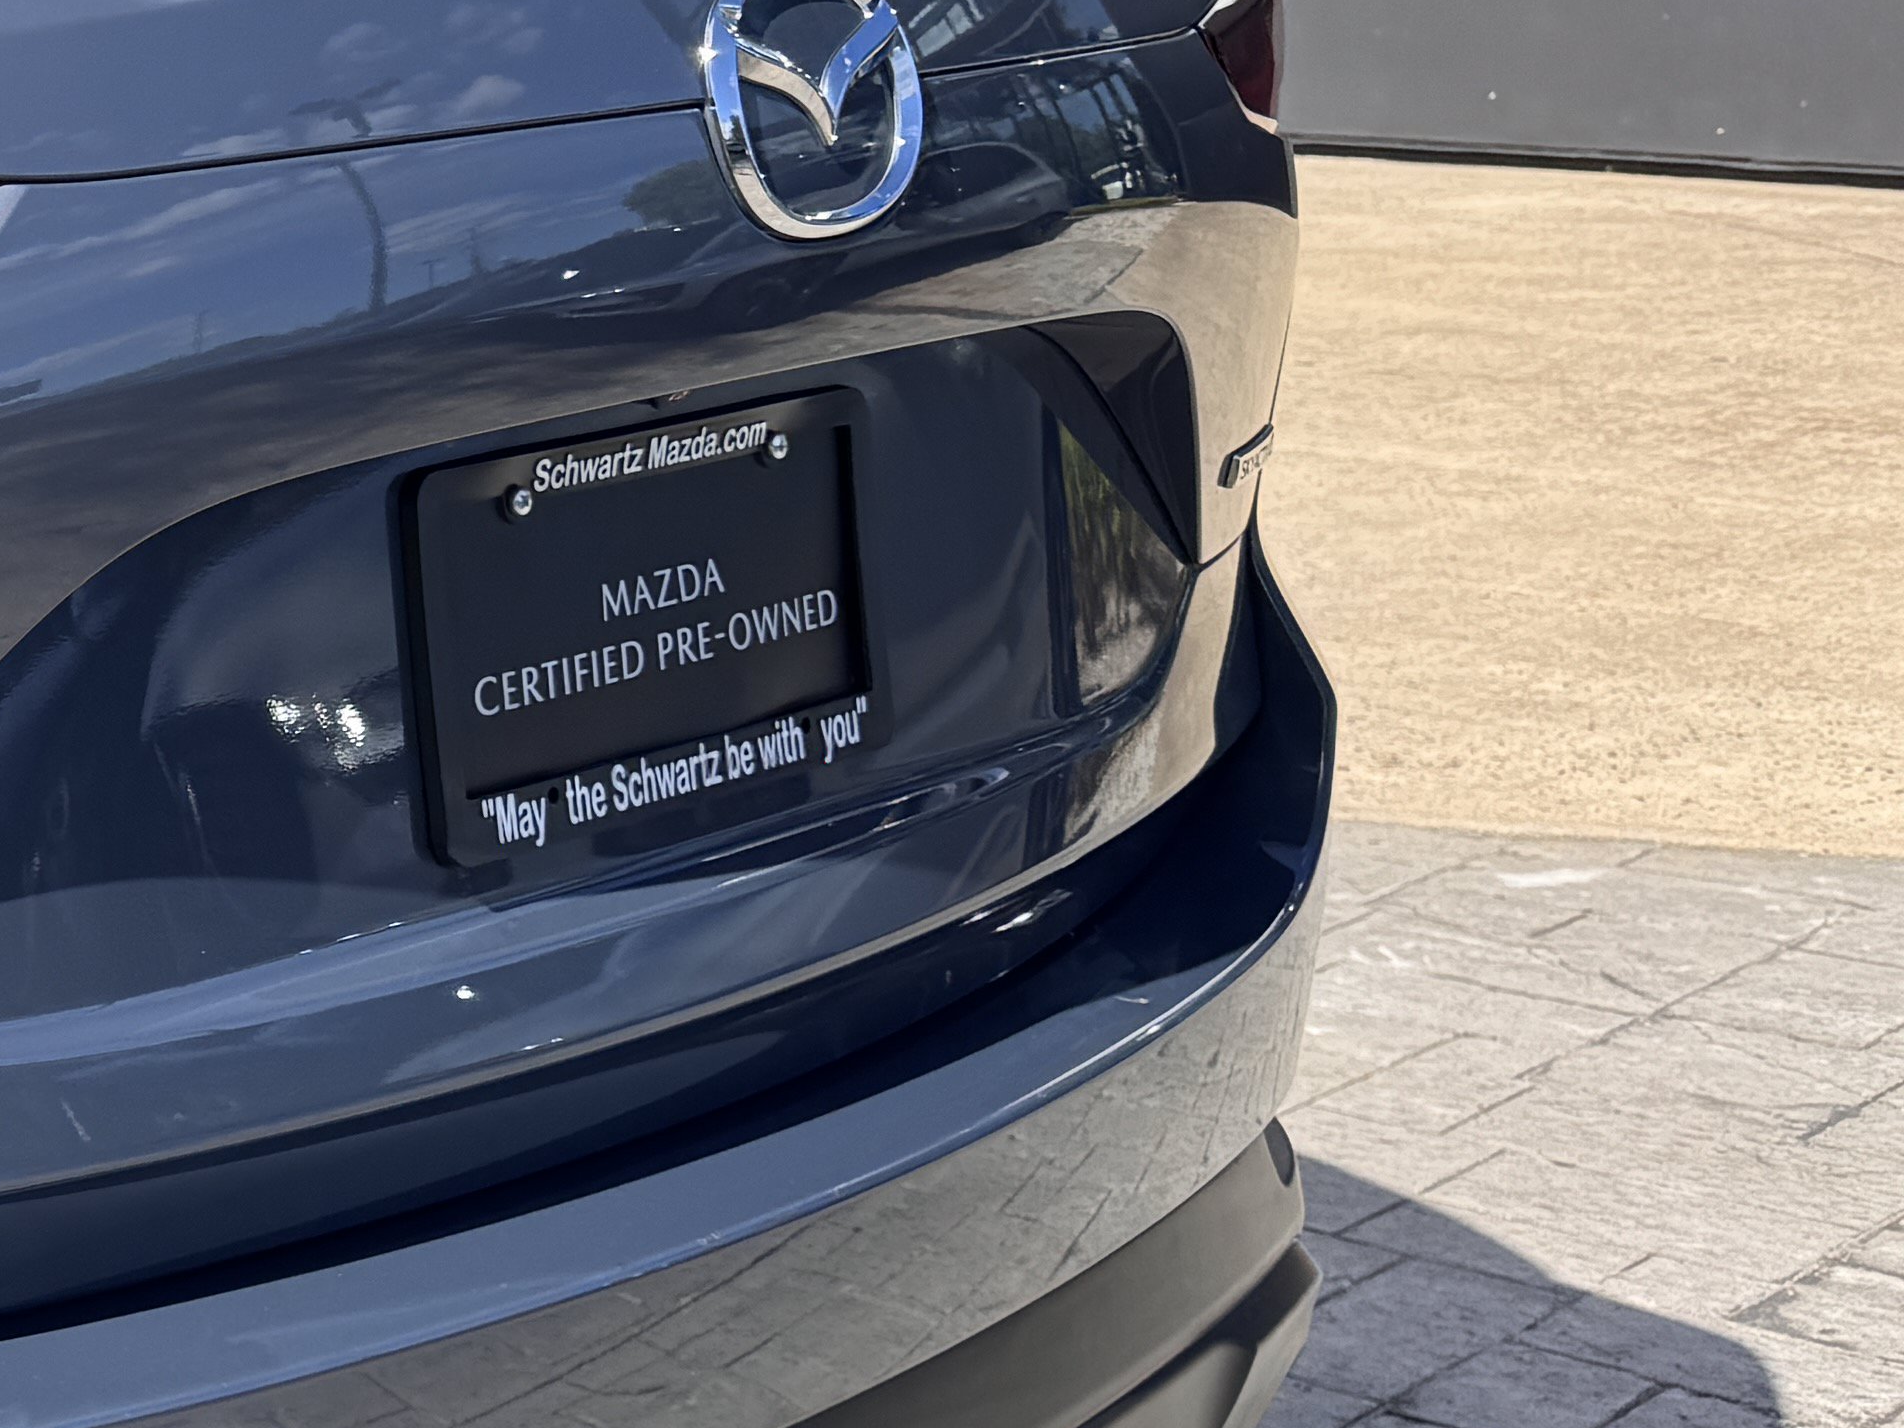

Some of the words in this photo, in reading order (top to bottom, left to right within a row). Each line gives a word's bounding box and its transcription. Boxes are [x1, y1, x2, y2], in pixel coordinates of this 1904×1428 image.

[533, 443, 644, 492] Schwartz
[647, 421, 767, 470] Mazda.com
[601, 558, 726, 621] MAZDA
[474, 640, 644, 716] CERTIFIED
[657, 589, 838, 671] PRE-OWNED
[481, 793, 547, 847] "May
[565, 774, 608, 825] the
[611, 742, 724, 812] Schwartz
[724, 734, 755, 781] be
[757, 716, 806, 770] with
[819, 695, 868, 764] you"
